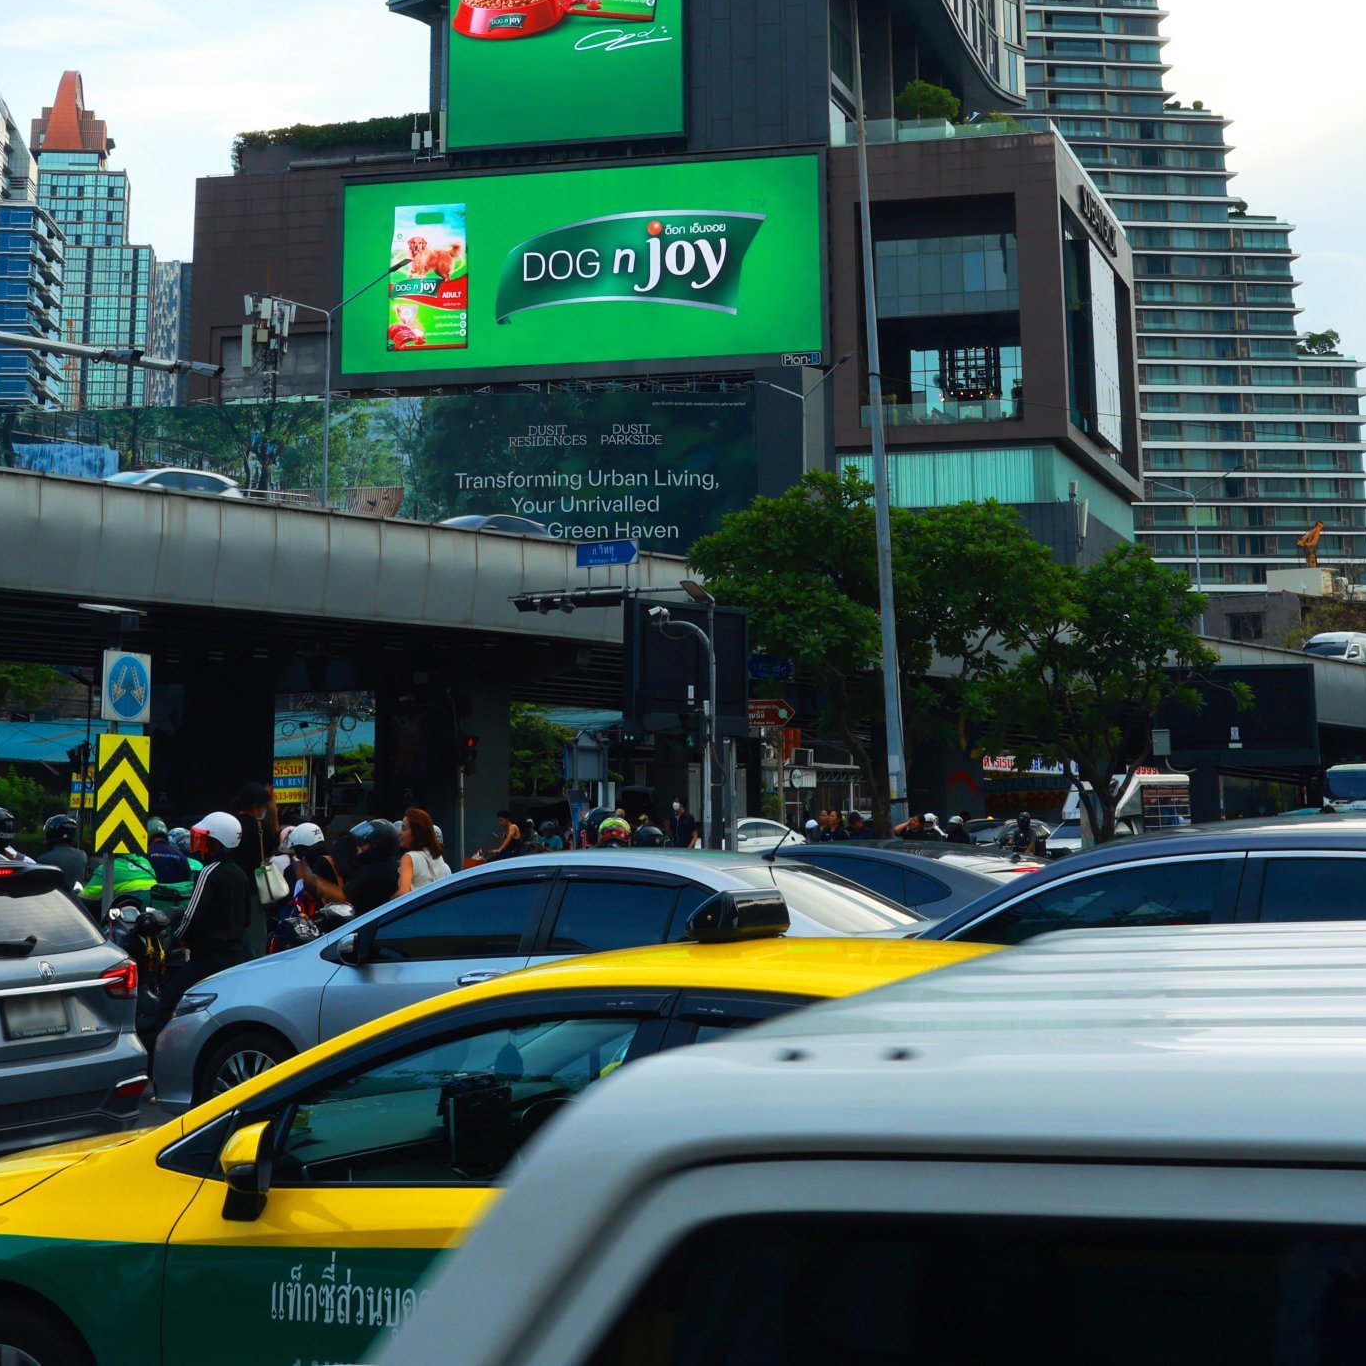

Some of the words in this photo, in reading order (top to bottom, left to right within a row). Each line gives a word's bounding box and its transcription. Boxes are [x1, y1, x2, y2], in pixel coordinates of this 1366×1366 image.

[664, 223, 686, 235] ด็อก
[689, 222, 727, 234] เอ็นจอย
[522, 248, 601, 282] DOG
[612, 248, 636, 274] n
[633, 222, 727, 292] joy
[395, 283, 412, 292] DOG
[419, 280, 437, 294] joy
[441, 291, 462, 299] ADULT
[528, 424, 568, 436] DUSIT
[612, 423, 651, 435] DUSIT
[509, 434, 587, 448] RESIDENCES
[600, 434, 663, 446] PARKSIDE
[454, 470, 582, 491] Transforming
[588, 469, 649, 487] Urban
[654, 469, 719, 491] Living,
[510, 496, 556, 514] Your
[560, 495, 660, 513] Unrivalled
[547, 521, 609, 539] Green
[614, 521, 679, 539] Haven
